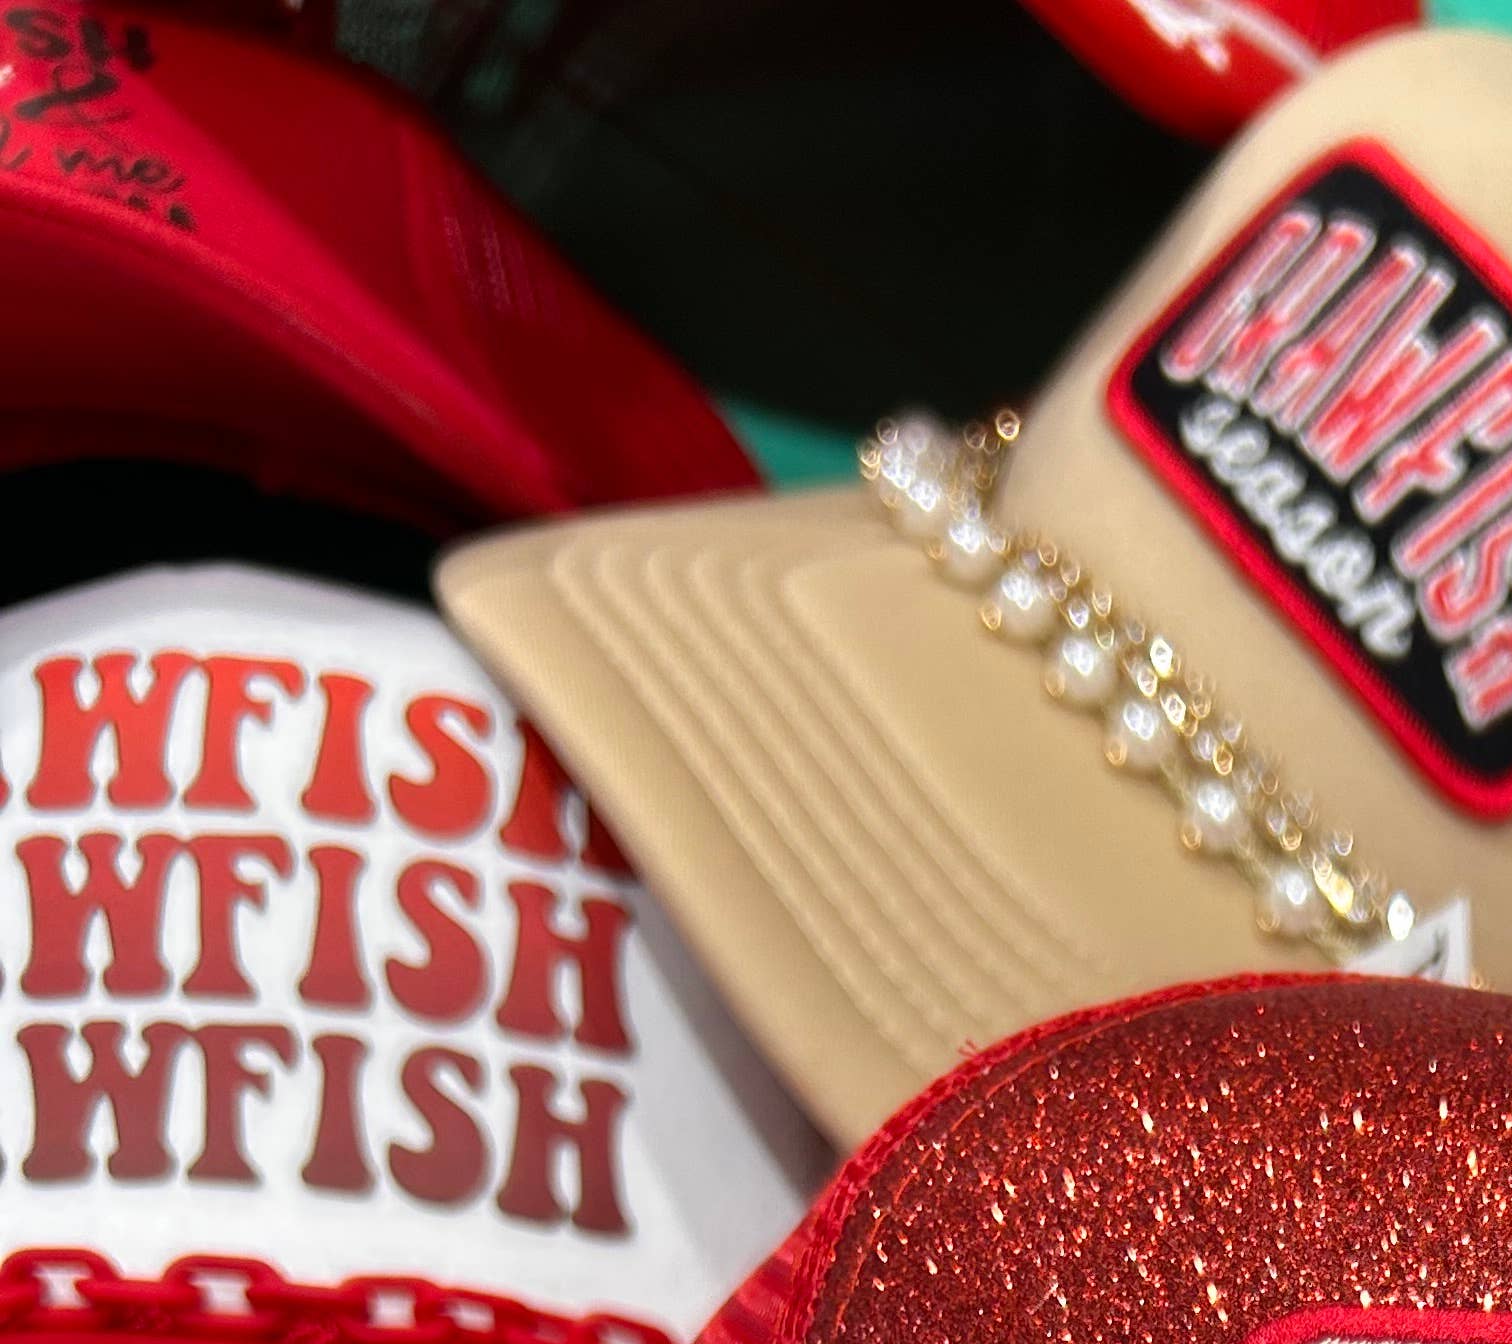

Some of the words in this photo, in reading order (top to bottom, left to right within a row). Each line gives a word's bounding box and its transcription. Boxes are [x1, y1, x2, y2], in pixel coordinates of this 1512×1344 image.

[1178, 396, 1412, 660] season
[0, 832, 639, 1062] WFISH
[0, 1020, 638, 1242] WFISH
